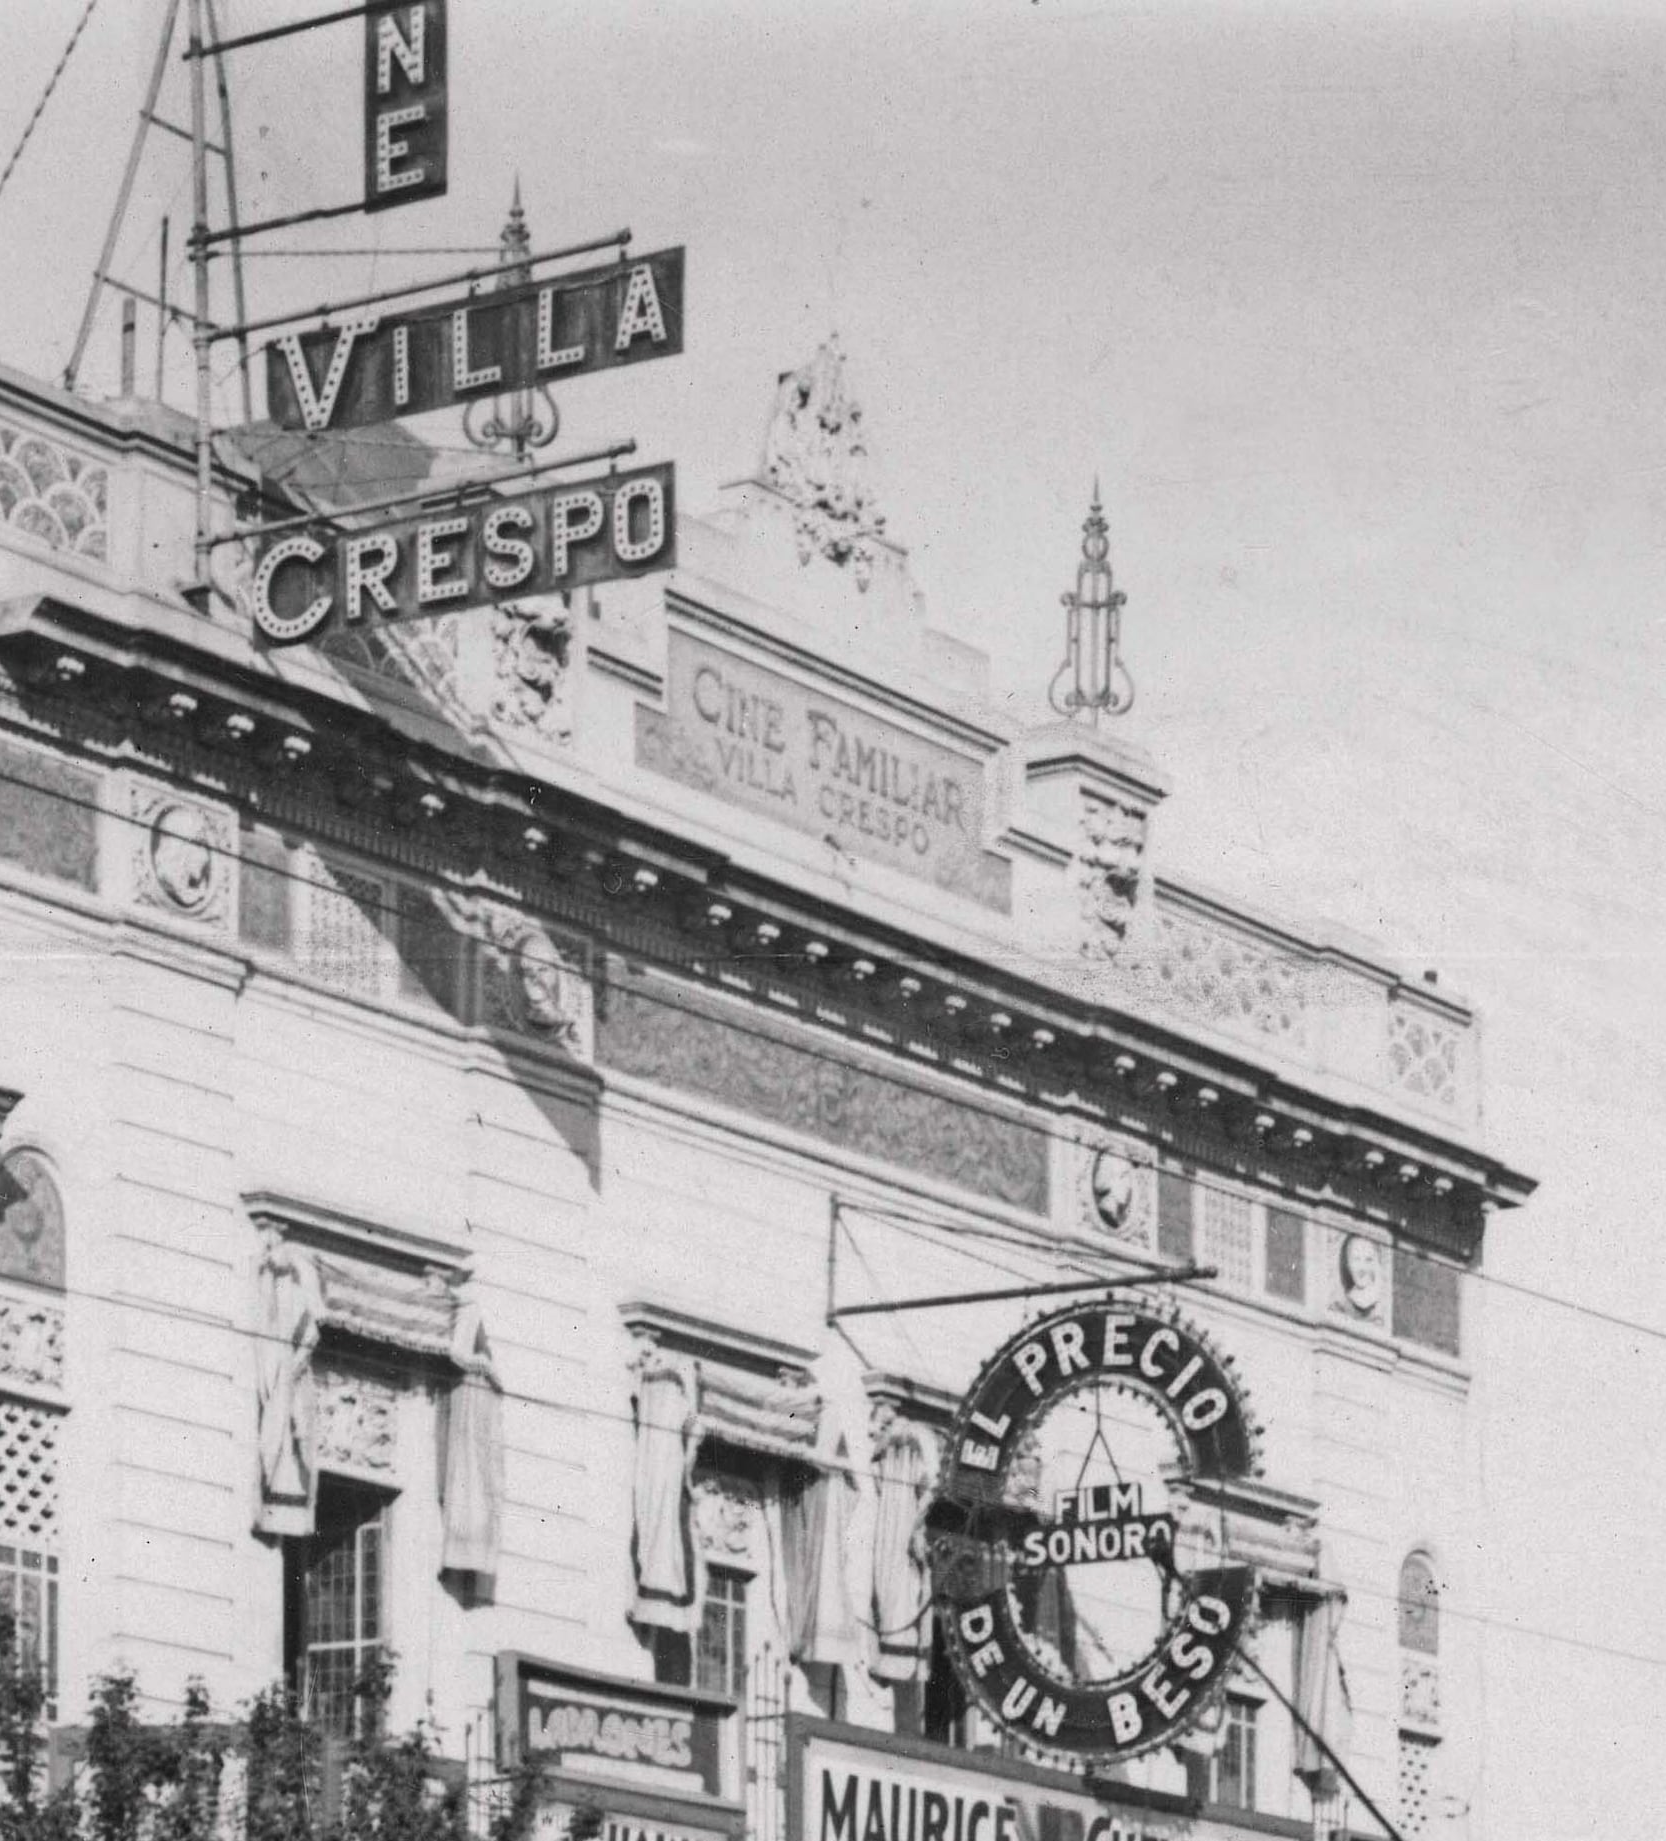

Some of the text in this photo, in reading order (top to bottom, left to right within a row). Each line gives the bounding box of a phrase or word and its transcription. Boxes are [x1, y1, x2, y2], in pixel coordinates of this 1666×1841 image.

[274, 262, 667, 432] VILLA
[252, 476, 665, 640] CRESPO
[693, 667, 969, 830] CINE FAMILIAR
[715, 736, 929, 856] VILLA CRESPO
[960, 1313, 1229, 1472] EL PRECIO
[1023, 1519, 1173, 1566] SONORO
[1054, 1483, 1141, 1525] FILM
[959, 1595, 1233, 1746] DE UN BESO
